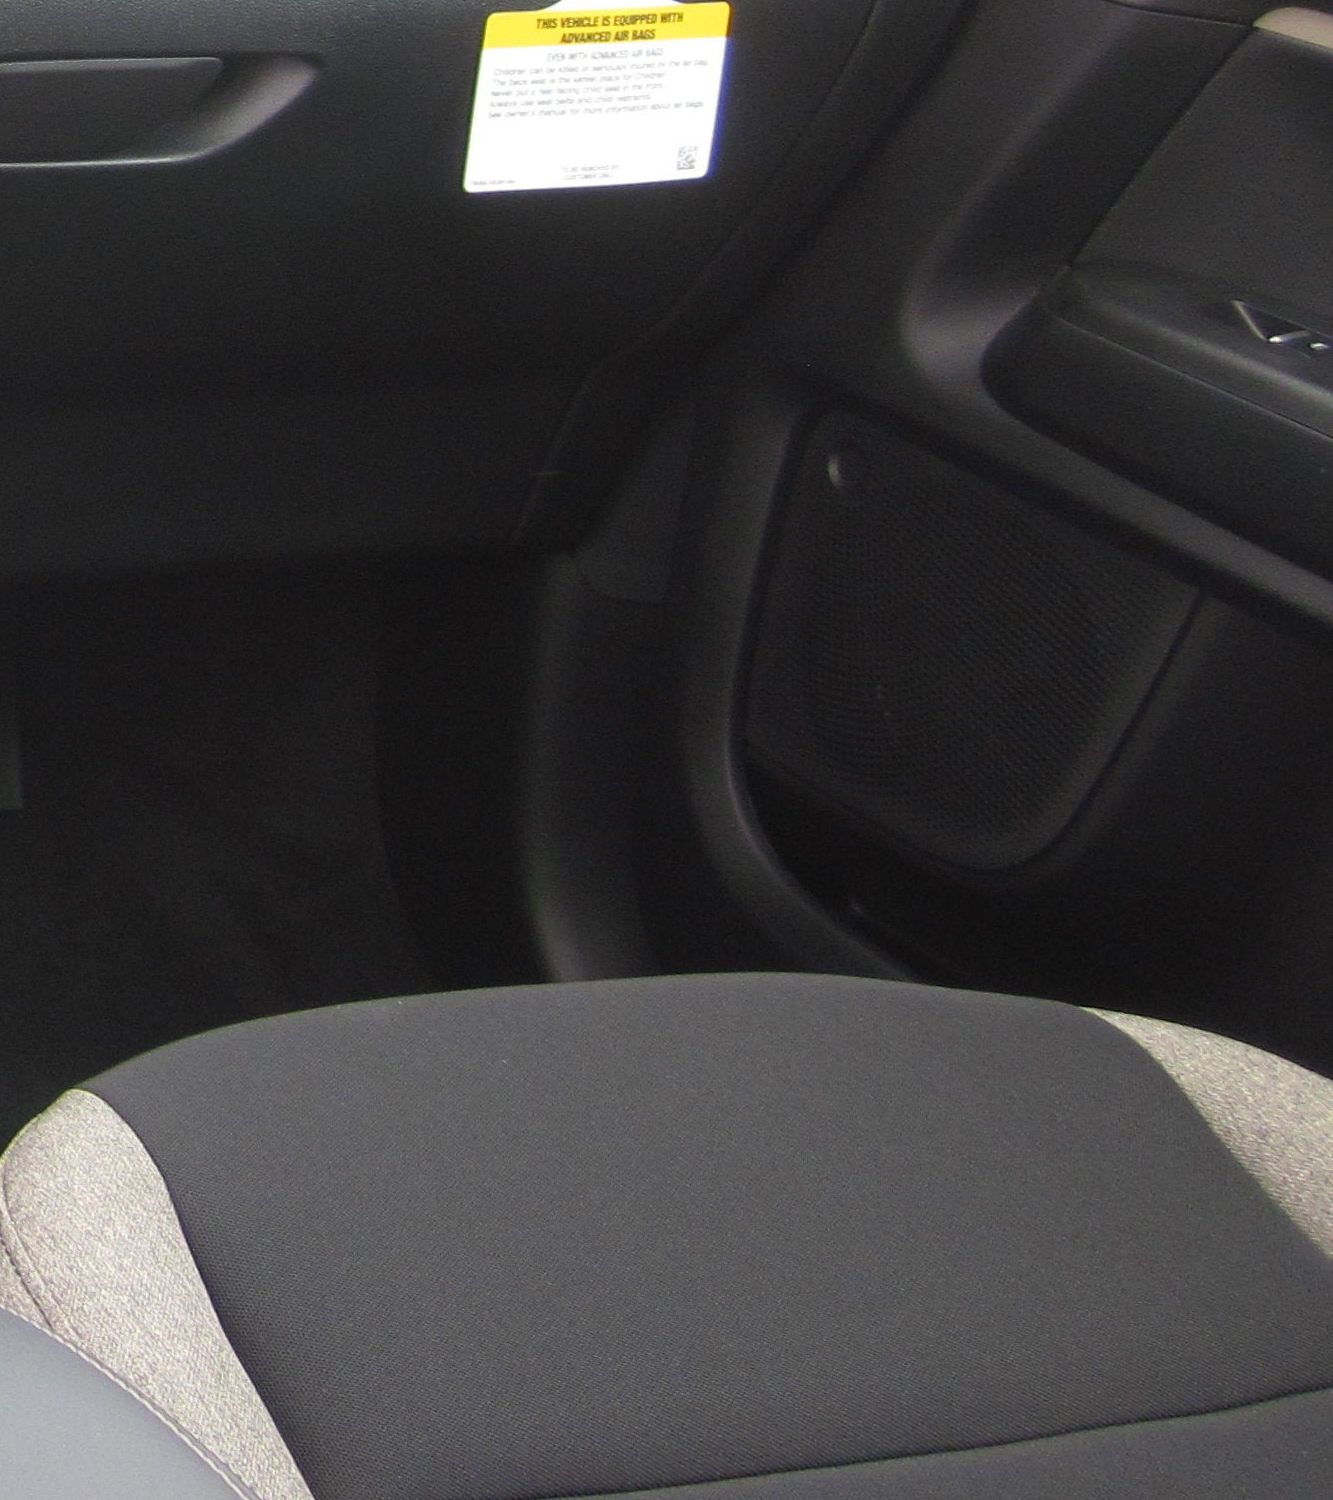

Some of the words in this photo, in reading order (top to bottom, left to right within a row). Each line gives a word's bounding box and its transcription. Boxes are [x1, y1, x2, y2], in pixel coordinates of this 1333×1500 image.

[536, 18, 558, 29] THIS
[560, 16, 599, 28] VEHICLE
[614, 13, 657, 26] EQUIPPED
[660, 12, 684, 23] WITH
[560, 31, 611, 44] ADVANCED
[614, 30, 630, 41] AIR
